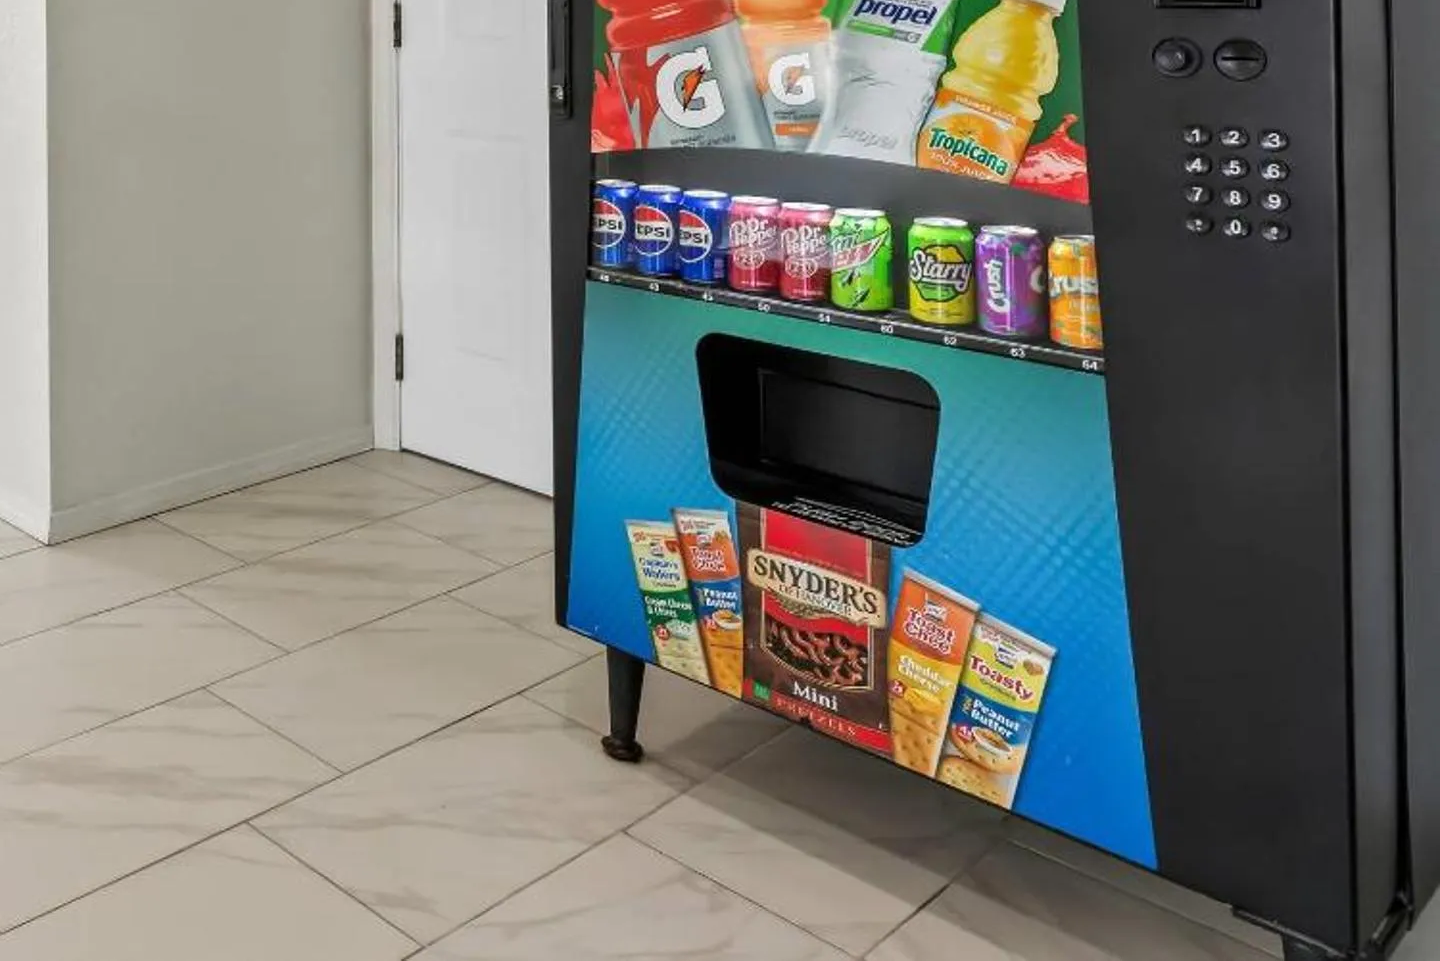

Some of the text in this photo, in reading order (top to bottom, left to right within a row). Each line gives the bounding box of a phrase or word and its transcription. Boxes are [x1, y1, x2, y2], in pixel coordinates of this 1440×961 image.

[768, 53, 815, 105] G
[656, 46, 726, 129] G
[1191, 129, 1201, 142] 1
[1227, 131, 1240, 144] 2
[1268, 133, 1280, 147] 3
[929, 127, 1008, 176] Tropicana
[1191, 158, 1202, 171] 4
[1229, 160, 1240, 174] 5
[1267, 164, 1280, 178] 6
[1192, 187, 1203, 201] 7
[1230, 191, 1241, 205] 8
[1268, 194, 1281, 209] 9
[637, 223, 670, 238] EPSI
[1230, 220, 1241, 234] 0
[679, 229, 708, 245] EPSI
[910, 249, 972, 291] Starry
[1082, 359, 1098, 370] 64
[753, 555, 878, 615] SNYDER'S
[971, 655, 1035, 701] Toasty
[793, 681, 838, 712] Mini
[973, 698, 1020, 732] Peanut
[971, 709, 1014, 739] Butter
